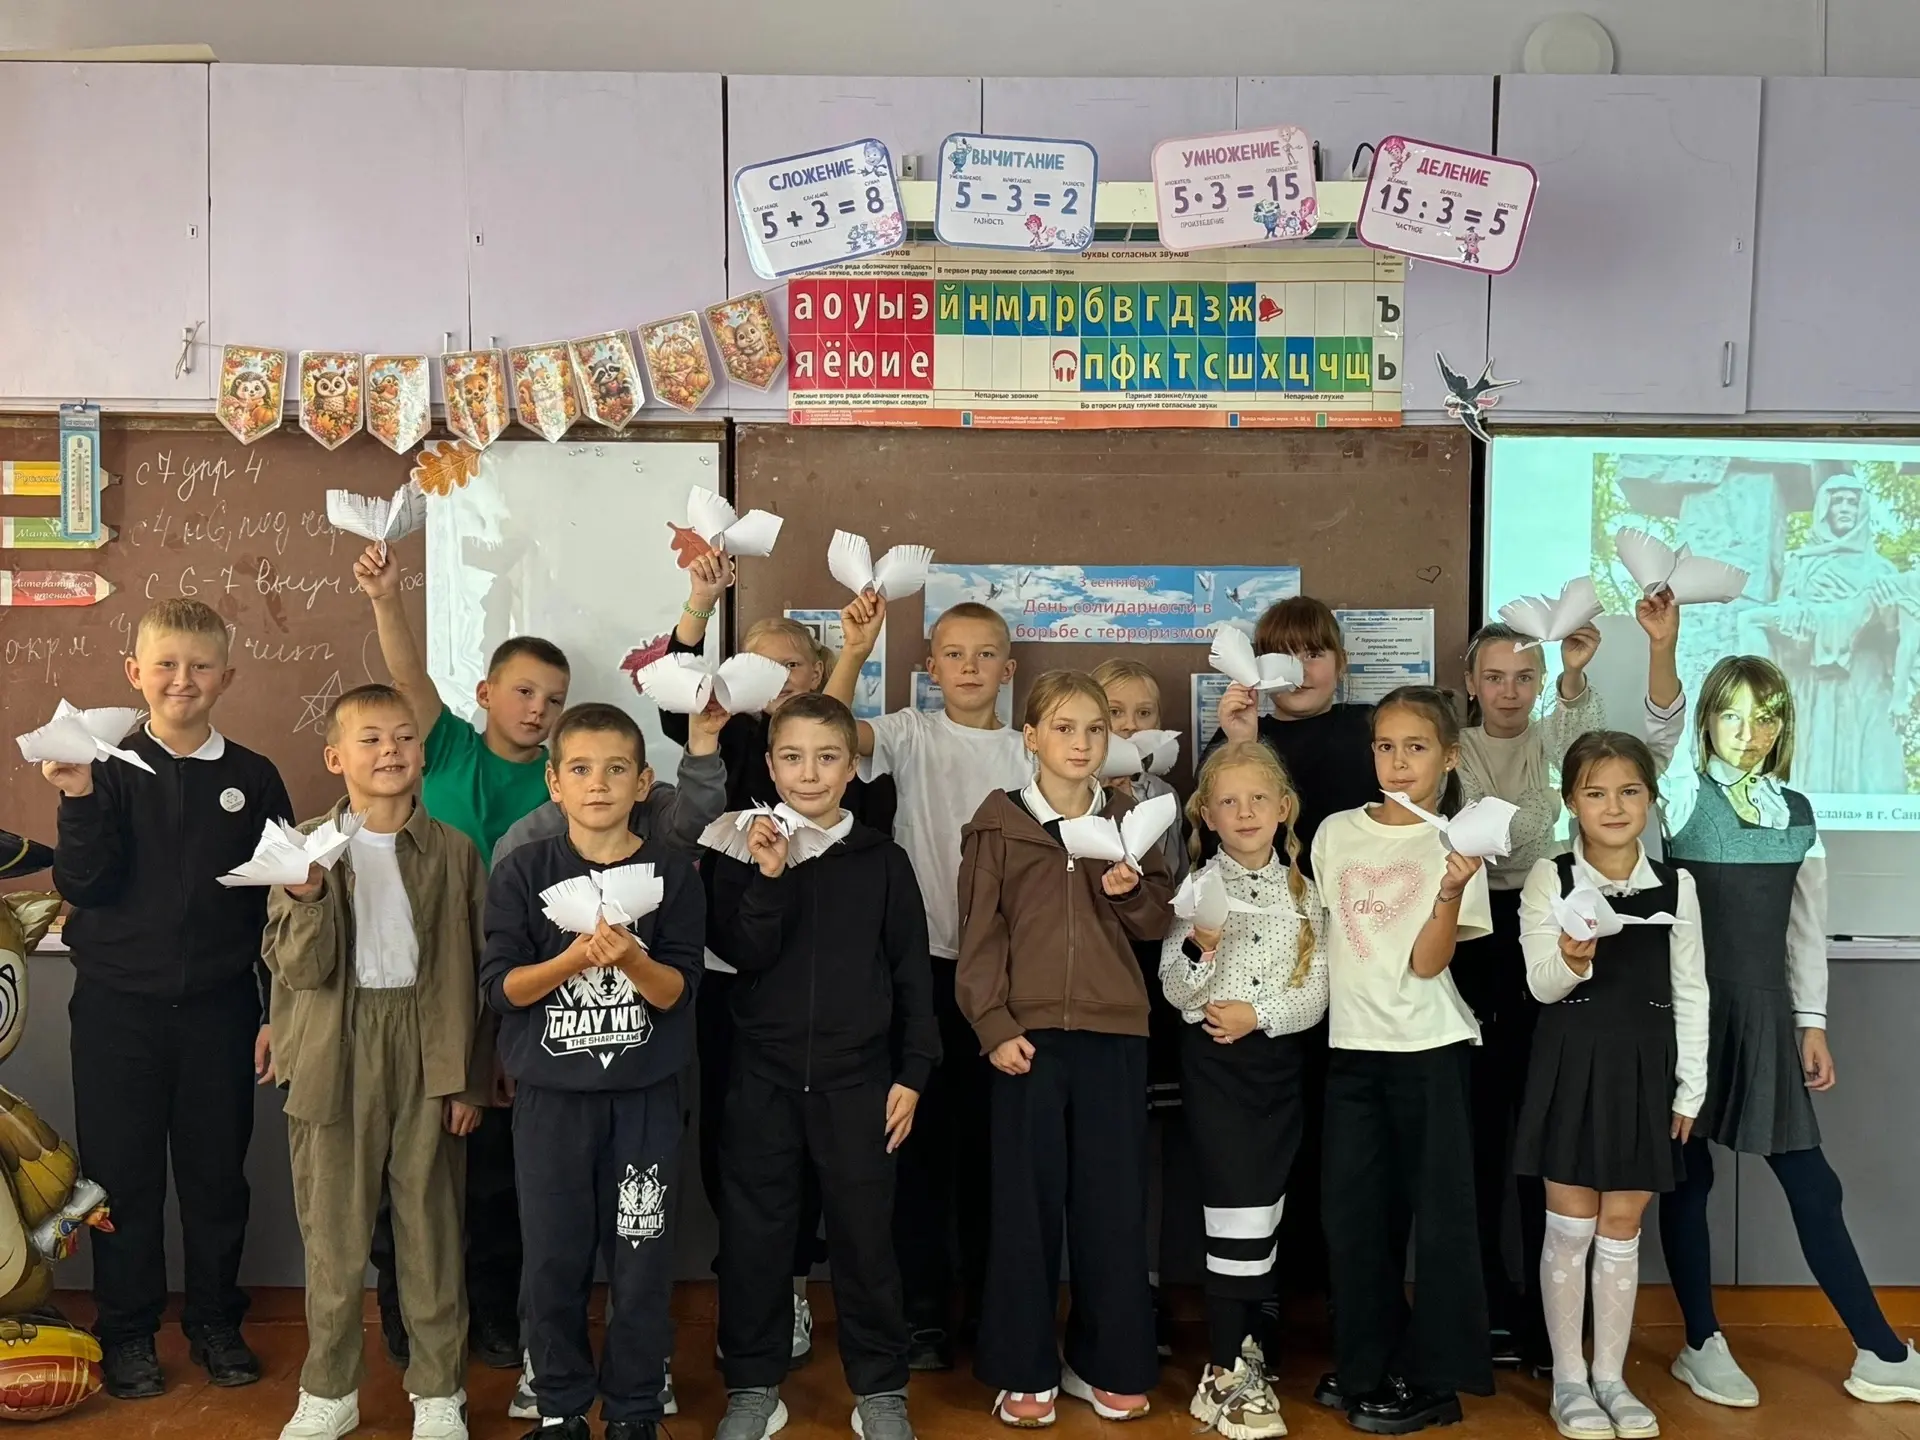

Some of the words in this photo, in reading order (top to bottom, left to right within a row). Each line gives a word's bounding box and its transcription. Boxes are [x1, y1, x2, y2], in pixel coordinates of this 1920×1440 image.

[971, 149, 1065, 171] ВЫЧИТАНИЕ
[1181, 140, 1281, 168] УМНОЖЕНИЕ
[768, 158, 856, 191] СЛОЖЕНИЕ
[1416, 157, 1491, 187] ДЕЛЕНИЕ
[1386, 176, 1408, 186] ДЕЛИМОЕ
[955, 181, 971, 209] 5
[1006, 184, 1022, 212] 3
[1060, 188, 1078, 215] 2
[1174, 185, 1190, 214] 5
[1210, 181, 1227, 210] 3
[1266, 172, 1300, 201] 15
[1440, 188, 1462, 198] ДЕЛИТЕЛЬ
[753, 202, 779, 213] СЛАГАЕМОЕ
[761, 211, 778, 239] 5
[811, 200, 830, 228] 3
[865, 186, 884, 214] 8
[1380, 184, 1412, 215] 15
[1436, 196, 1455, 225] 3
[1488, 208, 1509, 236] 5
[1497, 201, 1518, 211] ЧАСТНОЕ
[973, 217, 1004, 225] РАЗНОСТЬ
[1180, 217, 1225, 229] ПРОИЗВЕДЕНИЕ
[1395, 221, 1423, 234] ЧАСТНОЕ
[790, 238, 812, 248] СУММА
[1081, 251, 1109, 260] Буквы
[1111, 251, 1157, 259] согласных
[1159, 251, 1189, 259] звуков
[971, 268, 988, 276] ряду
[794, 292, 814, 321] а
[823, 292, 842, 321] о
[852, 292, 871, 329] у
[878, 293, 903, 321] ы
[912, 293, 929, 321] э
[940, 284, 959, 321] й
[969, 293, 989, 322] н
[995, 294, 1020, 322] м
[1027, 294, 1047, 322] л
[1055, 294, 1075, 331] р
[1084, 286, 1104, 323] б
[1113, 295, 1133, 322] в
[1145, 295, 1160, 322] г
[1171, 295, 1194, 328] д
[1203, 295, 1220, 323] з
[1228, 295, 1253, 323] ж
[794, 350, 814, 379] я
[823, 340, 842, 379] ё
[849, 350, 874, 379] ю
[881, 351, 900, 379] и
[910, 350, 930, 379] е
[1084, 352, 1103, 380] п
[1110, 343, 1136, 389] ф
[1143, 352, 1162, 380] к
[1173, 353, 1191, 380] т
[1203, 352, 1220, 380] с
[1228, 353, 1253, 380] ш
[1260, 353, 1280, 380] х
[1289, 353, 1310, 387] ц
[1319, 353, 1338, 380] ч
[1346, 353, 1370, 387] щ
[974, 392, 1009, 400] Непарные
[1125, 392, 1152, 400] Парные
[1284, 393, 1319, 401] Непарные
[1118, 402, 1135, 410] ряду
[1198, 402, 1218, 410] звуки
[157, 450, 175, 484] 7
[177, 456, 235, 501] упр
[245, 450, 263, 484] 4
[153, 508, 172, 547] 4
[1079, 575, 1086, 588] 3
[1091, 575, 1156, 590] сентября
[1023, 600, 1068, 615] День
[1073, 601, 1197, 617] солидарности
[1203, 603, 1212, 614] в
[1016, 623, 1079, 641] борьбе
[1084, 627, 1093, 638] с
[1099, 627, 1219, 641] терроризмом
[1814, 808, 1861, 820] слана»
[1866, 812, 1874, 820] в
[1877, 811, 1888, 820] г.
[549, 1008, 607, 1039] GRAY
[610, 1004, 647, 1032] WOL
[570, 1037, 587, 1047] THE
[588, 1034, 615, 1045] SHARP
[615, 1031, 640, 1042] CLAWS
